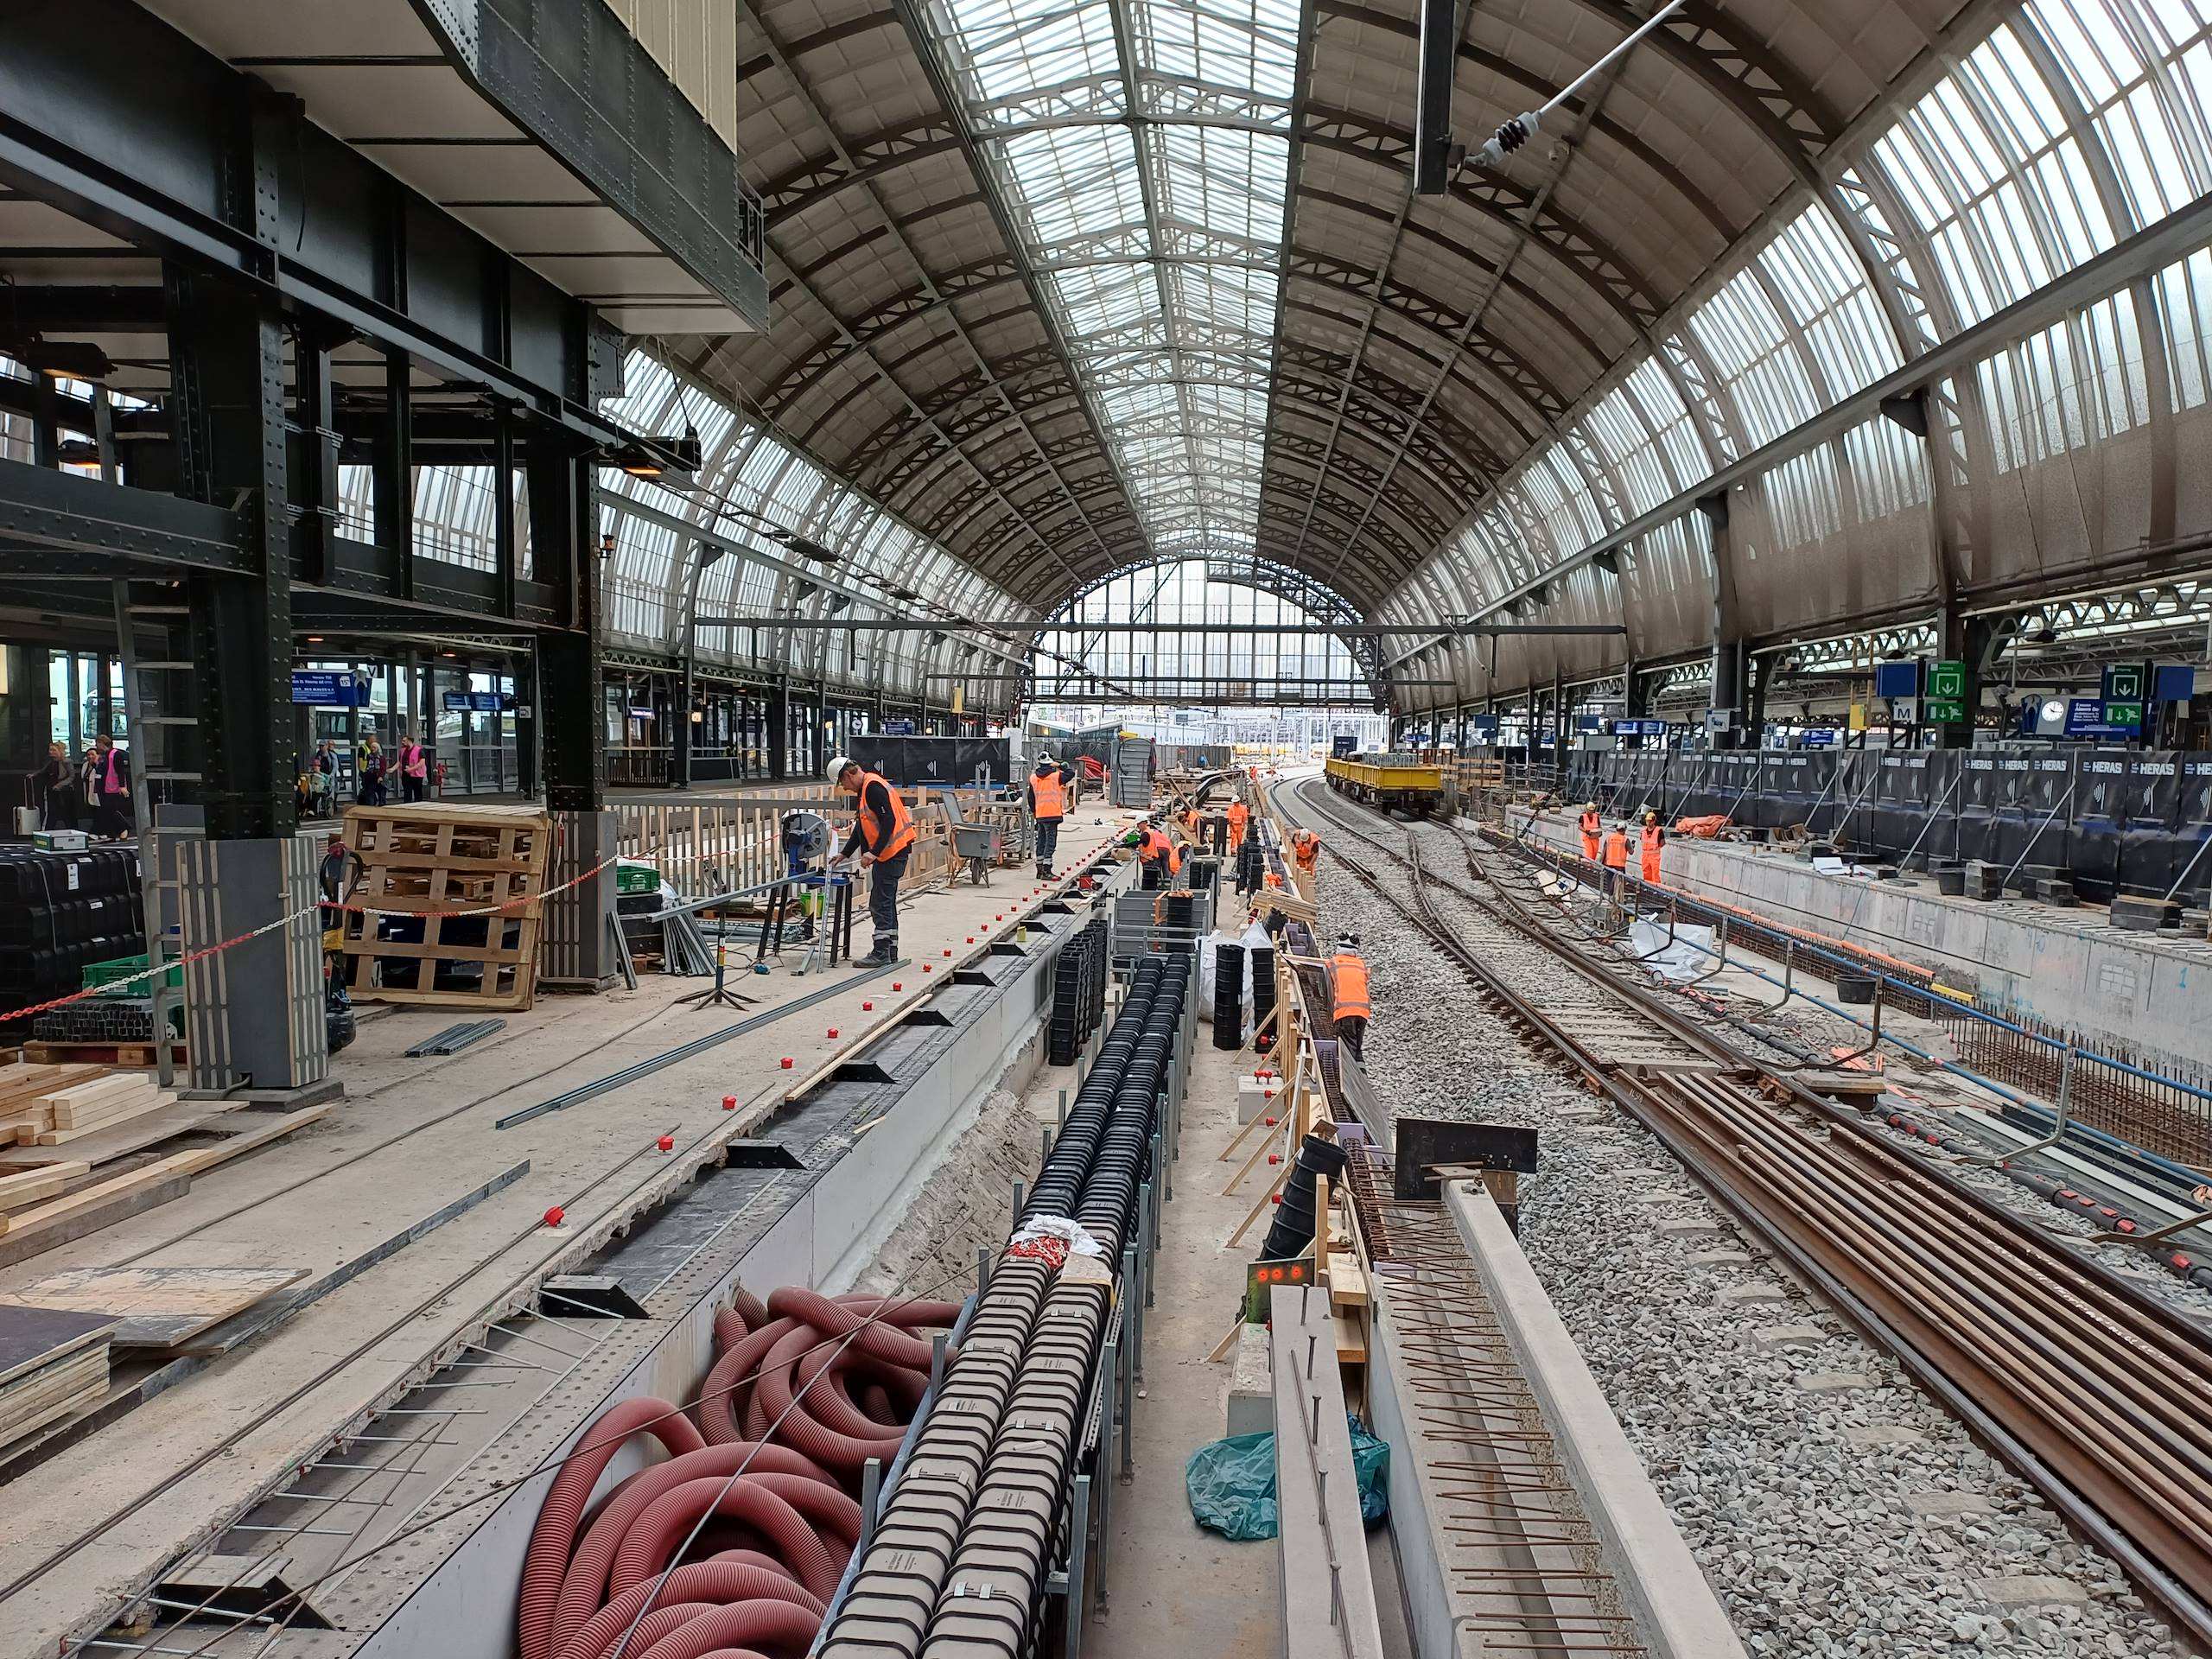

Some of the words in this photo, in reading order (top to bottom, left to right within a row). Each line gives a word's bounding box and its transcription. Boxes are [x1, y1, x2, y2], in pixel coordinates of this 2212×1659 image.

[1897, 708, 1910, 719] M
[1970, 760, 1993, 770] HERAS
[2005, 760, 2029, 771] HERAS
[2042, 760, 2067, 771] HERAS
[2092, 761, 2123, 774] HERAS
[2140, 762, 2175, 775] HERAS
